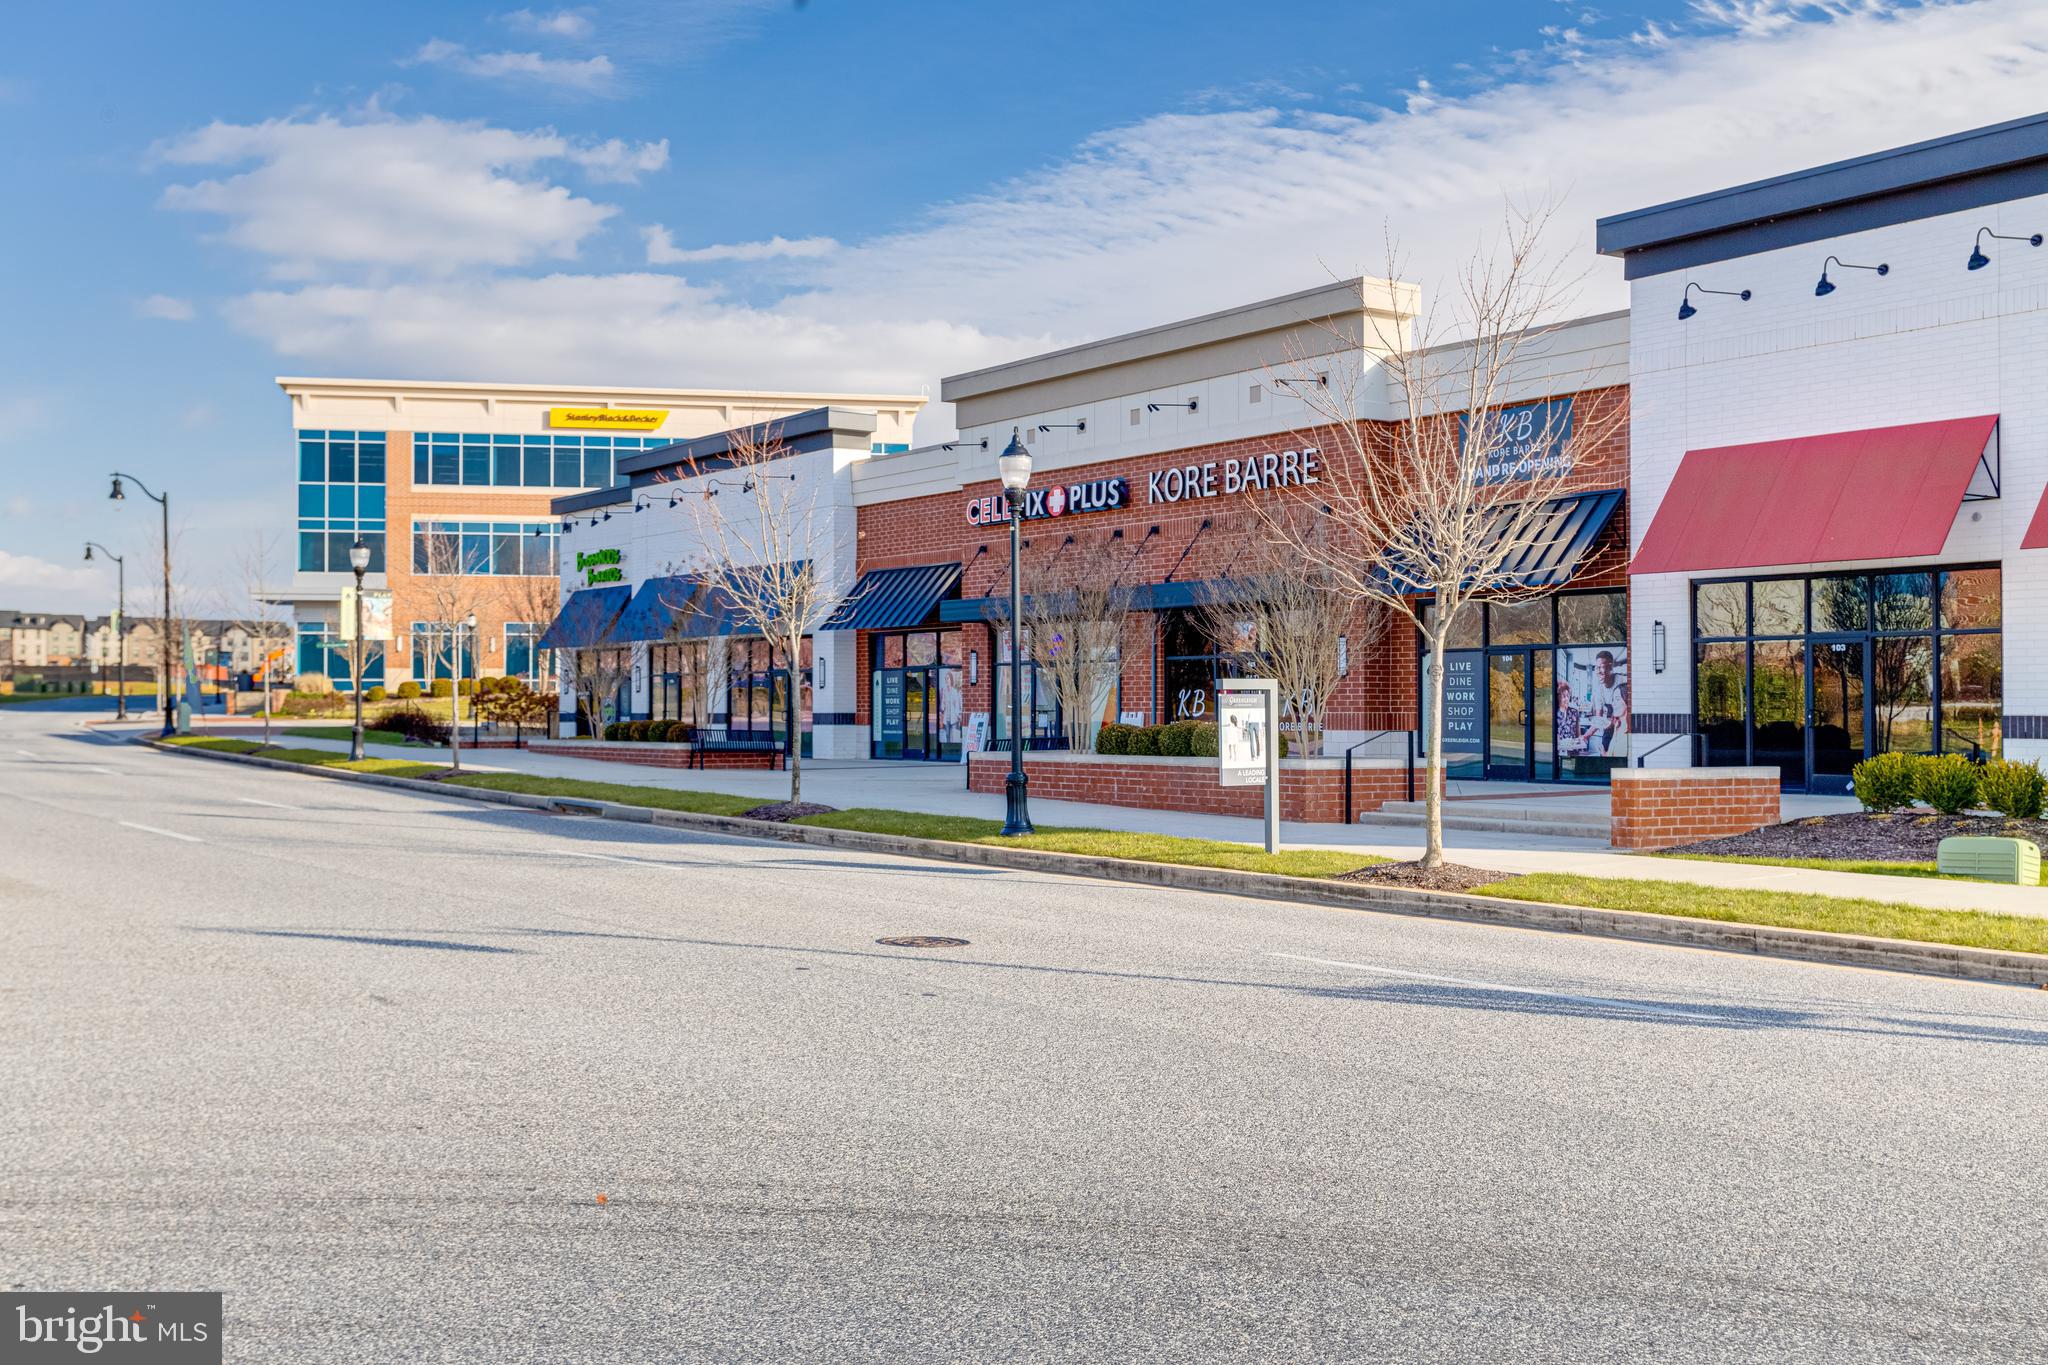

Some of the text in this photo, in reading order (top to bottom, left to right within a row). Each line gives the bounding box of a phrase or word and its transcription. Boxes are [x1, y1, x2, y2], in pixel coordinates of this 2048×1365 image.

[1499, 410, 1533, 442] KB
[1149, 448, 1319, 504] KORE BARRE
[1069, 479, 1120, 511] PLUS
[1449, 662, 1472, 671] LIVE
[1449, 677, 1472, 686] DINE
[1446, 692, 1475, 701] WORK
[1177, 688, 1206, 717] KB
[1447, 706, 1474, 716] SHOP
[1278, 721, 1296, 732] ORE
[1448, 722, 1473, 731] PLAY
